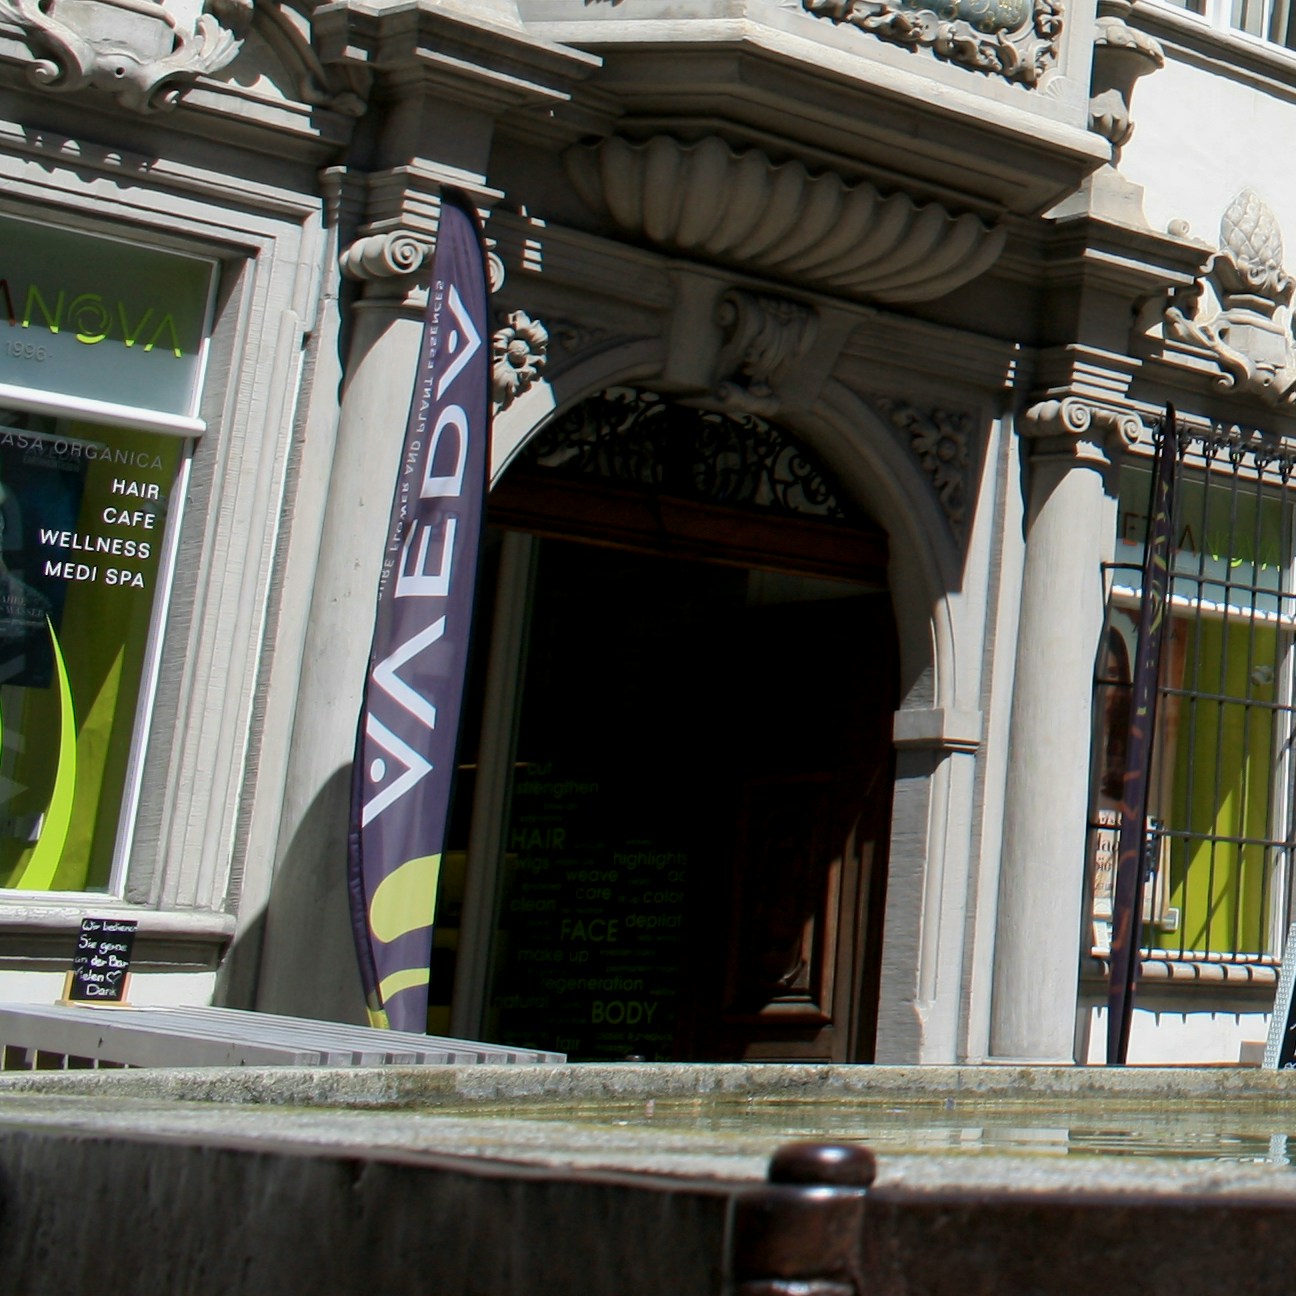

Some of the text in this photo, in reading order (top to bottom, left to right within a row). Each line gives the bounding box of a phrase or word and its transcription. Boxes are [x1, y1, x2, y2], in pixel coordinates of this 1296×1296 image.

[1, 435, 44, 451] ASA
[54, 439, 164, 471] ORGANICA
[112, 478, 160, 500] HAIR
[103, 507, 156, 530] CAFE
[40, 528, 151, 559] WELLNESS
[44, 560, 145, 589] MEDI SPA
[515, 780, 599, 799] strengthen
[512, 828, 567, 851] HAIR
[613, 850, 688, 870] highlights
[566, 869, 619, 883] weave
[510, 896, 556, 912] clean
[576, 887, 613, 901] care
[560, 919, 619, 943] FACE
[79, 934, 97, 949] Sie
[91, 955, 107, 966] der
[109, 955, 129, 968] Bar
[517, 947, 564, 962] make
[569, 948, 590, 964] up
[86, 984, 117, 996] Dank
[540, 974, 644, 994] regeneration
[591, 1000, 659, 1025] BODY
